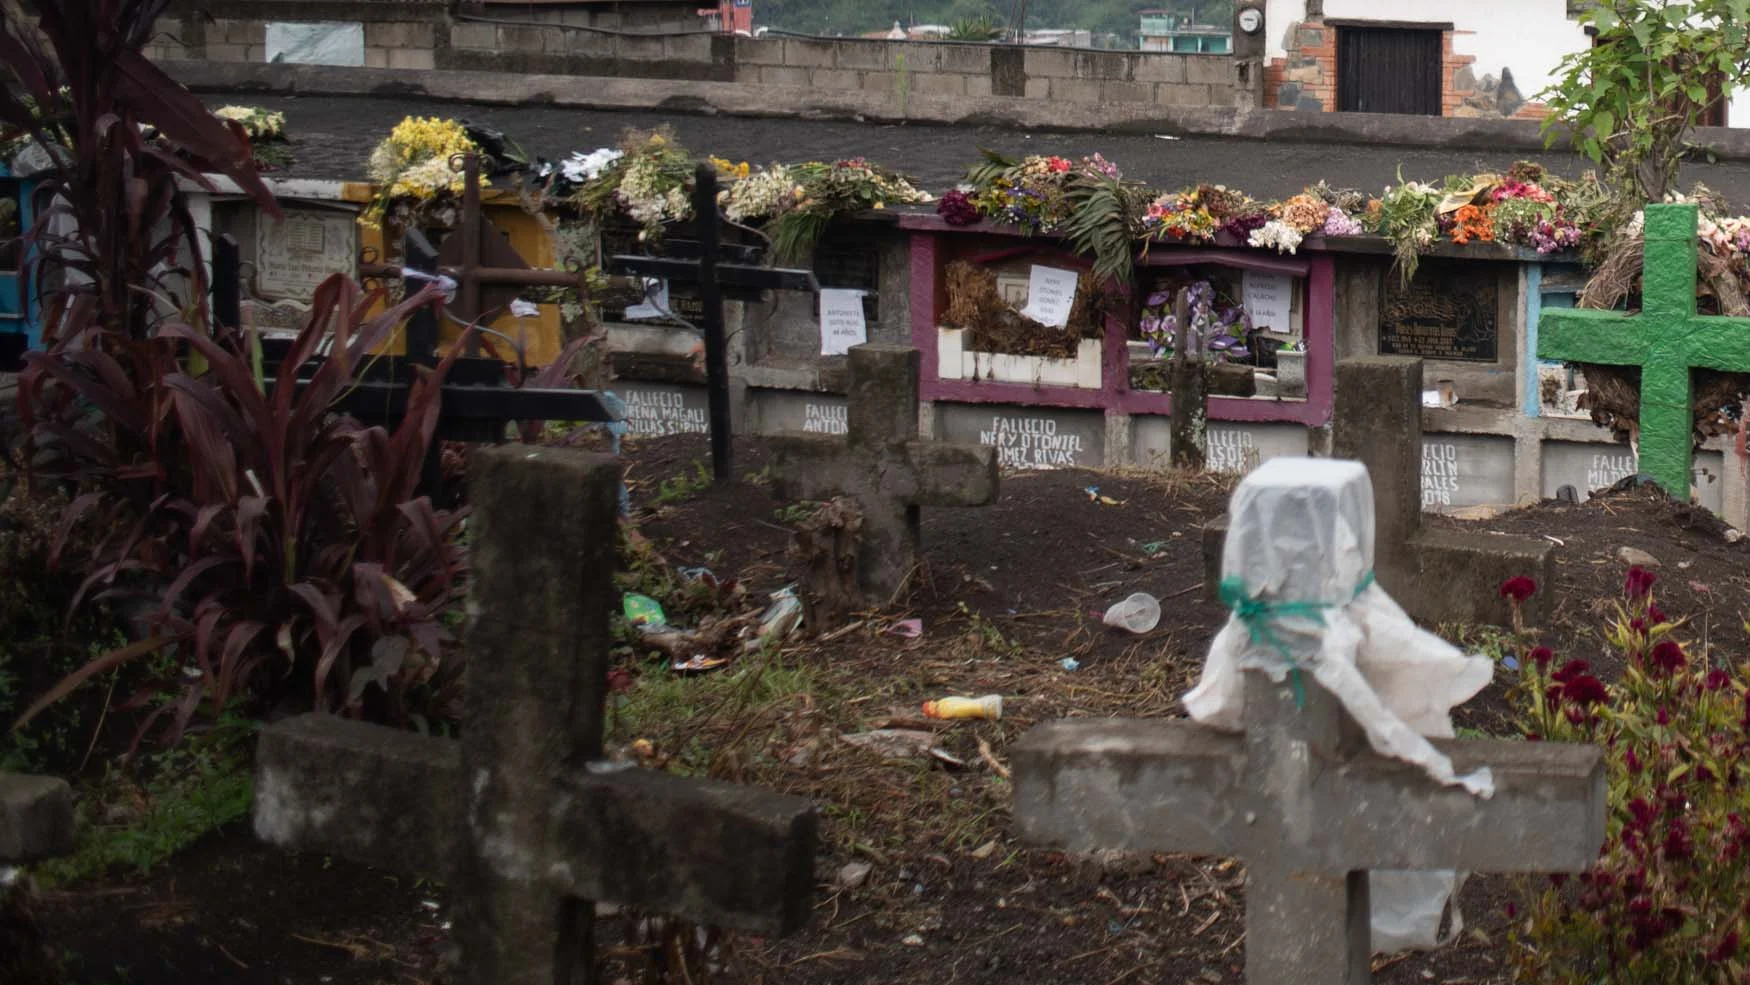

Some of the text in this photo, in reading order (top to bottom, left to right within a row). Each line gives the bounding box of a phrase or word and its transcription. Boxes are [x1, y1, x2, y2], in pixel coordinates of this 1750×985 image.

[662, 407, 704, 423] MAGALI
[806, 403, 848, 420] FALLECI
[803, 420, 848, 435] ANTON
[993, 416, 1057, 435] FALLECIO
[980, 431, 1083, 452] NERY OTONIEL
[1207, 430, 1252, 448] LLECIO
[1034, 448, 1075, 466] RIVAS
[1422, 443, 1456, 461] ECIO
[1593, 455, 1638, 471] FALLE
[1421, 476, 1459, 491] ALES
